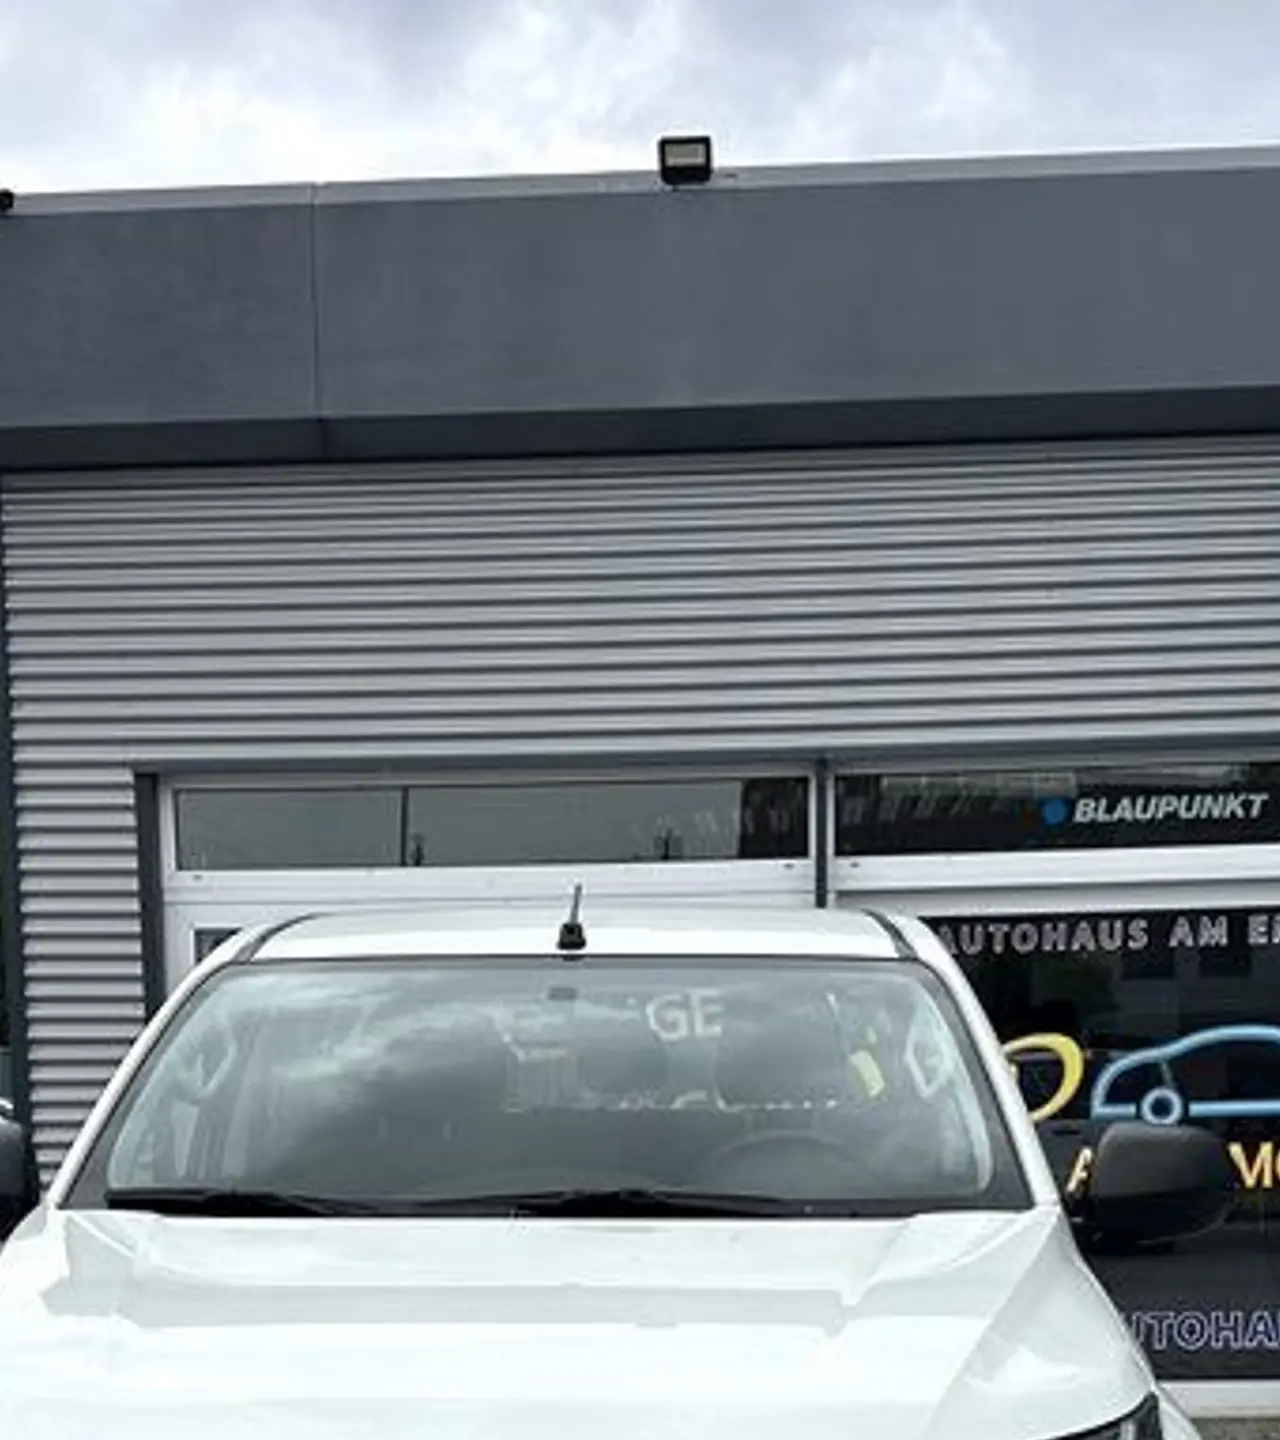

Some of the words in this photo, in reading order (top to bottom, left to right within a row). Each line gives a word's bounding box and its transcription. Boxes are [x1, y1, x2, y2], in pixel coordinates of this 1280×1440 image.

[1073, 792, 1269, 823] BLAUPUNKT
[936, 918, 1150, 955] AUTOHAUS
[1169, 915, 1230, 947] AM
